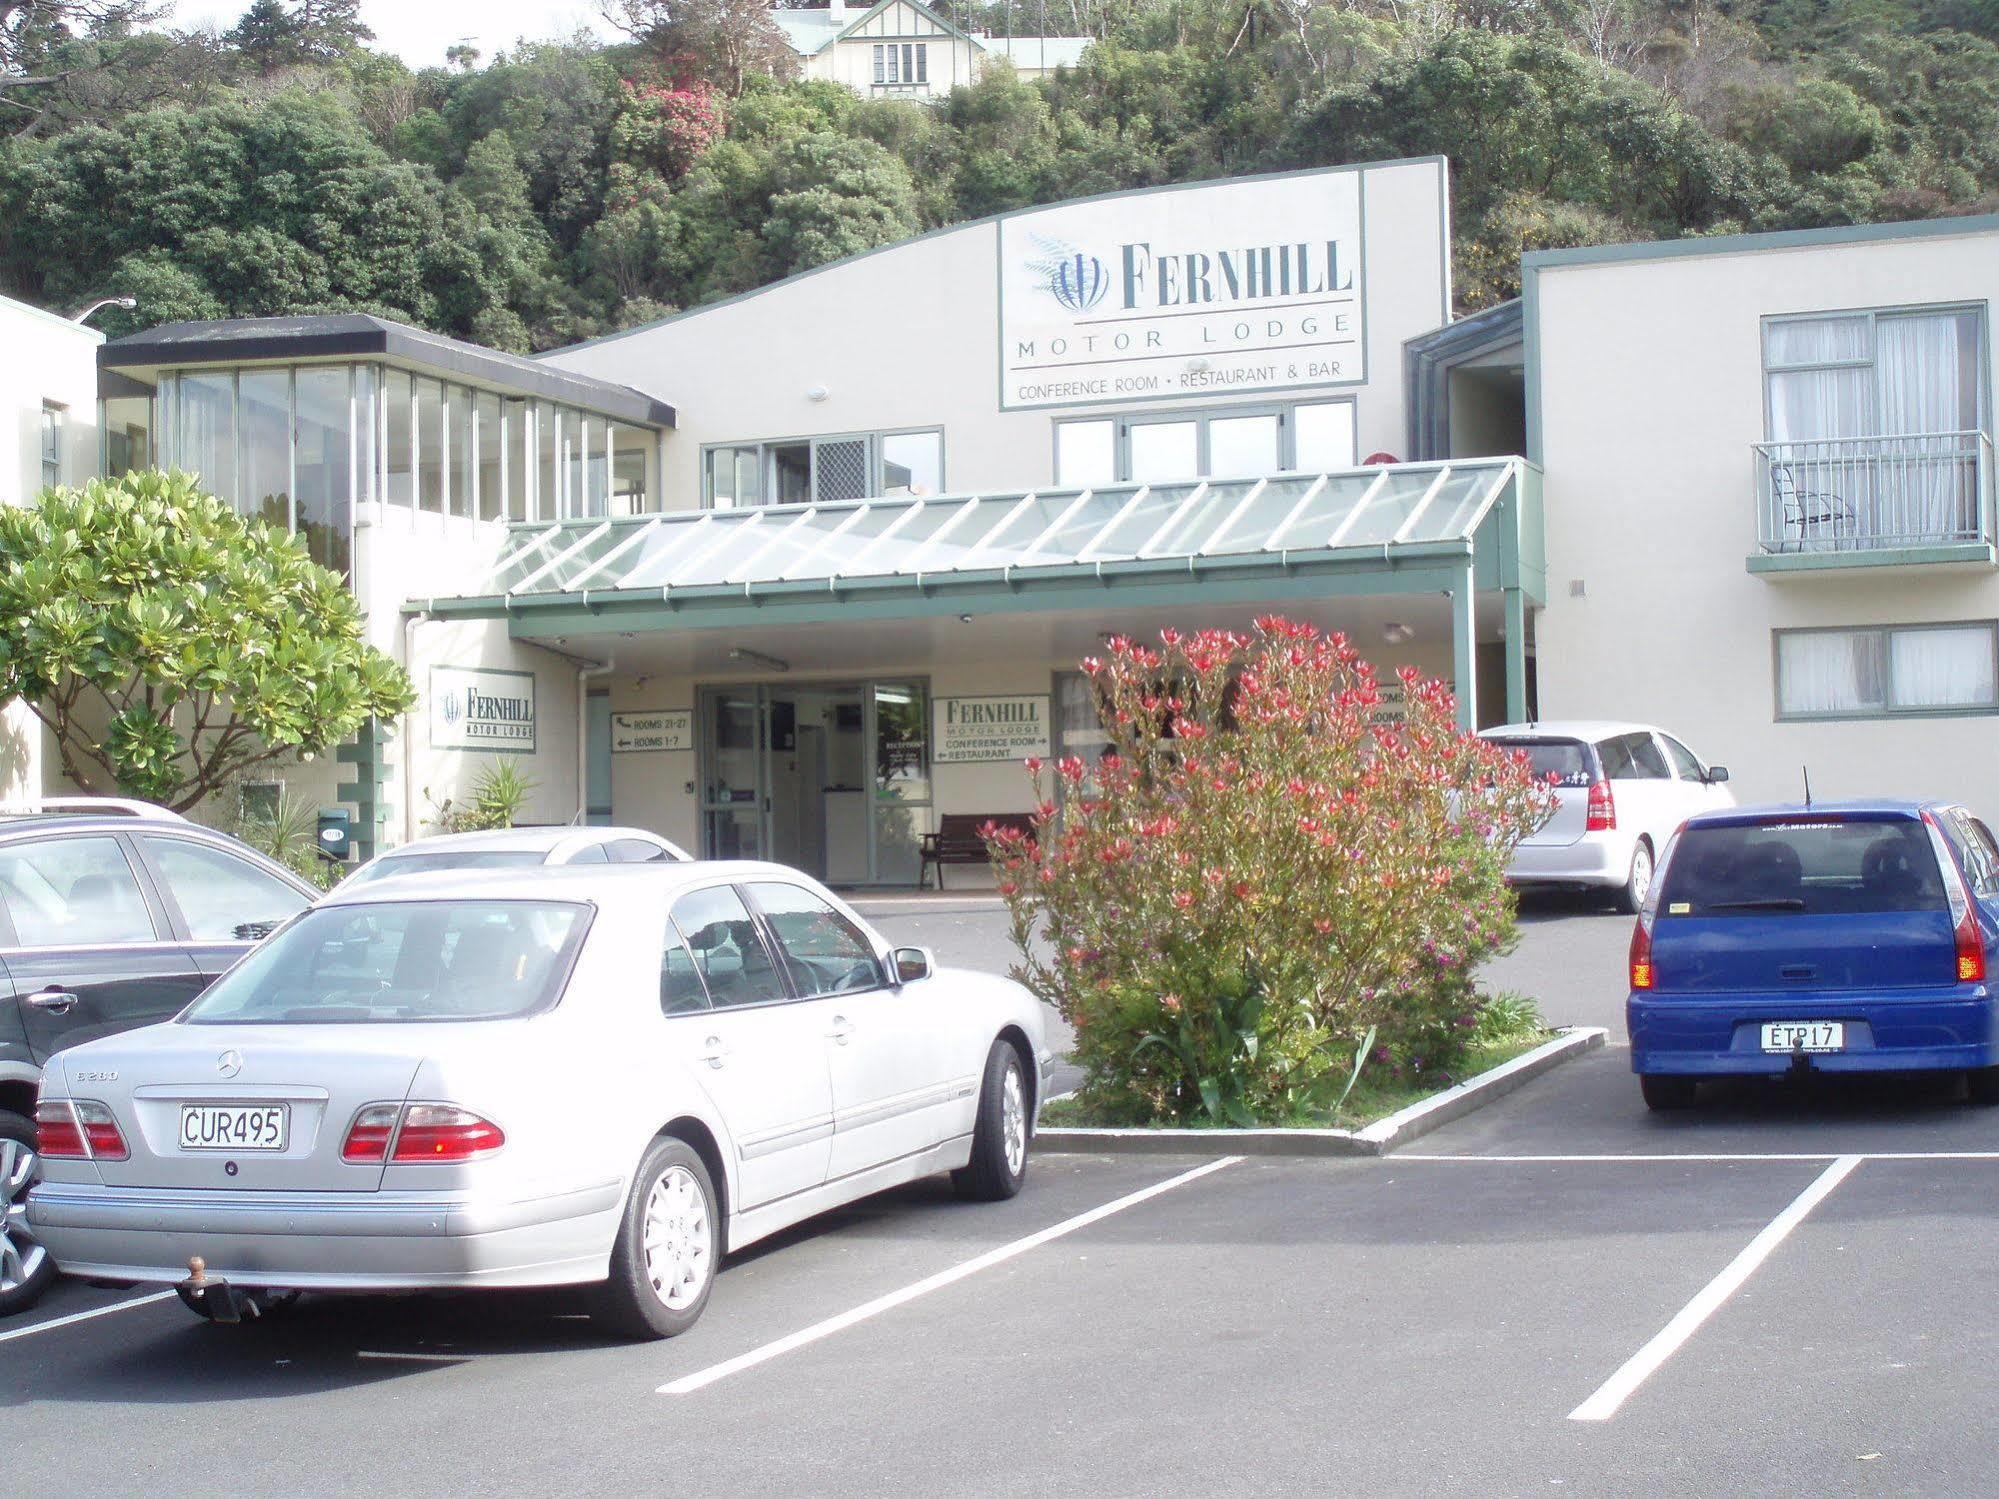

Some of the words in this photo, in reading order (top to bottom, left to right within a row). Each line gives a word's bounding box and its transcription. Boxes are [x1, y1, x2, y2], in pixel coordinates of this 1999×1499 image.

[1121, 240, 1353, 310] FERNHILL
[1018, 330, 1163, 358] MOTOR
[1203, 315, 1350, 343] LODGE
[1019, 379, 1107, 400] CONFERENCE
[1115, 376, 1159, 391] ROOM
[1180, 366, 1276, 388] RESTAURANT
[1287, 364, 1298, 379] &
[1309, 361, 1341, 376] BAR
[467, 687, 533, 721] FERNHILL
[1382, 693, 1404, 704] OMS
[947, 700, 1040, 724] FERNHILL
[634, 719, 662, 730] ROOMS
[665, 718, 687, 729] 21-27
[466, 725, 497, 735] MOTOR
[504, 726, 533, 737] LODGE
[947, 726, 994, 736] MOTOR
[1000, 725, 1040, 734] LODGE
[634, 736, 663, 747] ROOMS
[665, 736, 679, 746] 1-7
[945, 738, 1008, 749] CONFERENCE
[1010, 737, 1036, 747] ROOM
[948, 749, 1011, 760] RESTAURANT
[185, 1111, 280, 1144] CUR495
